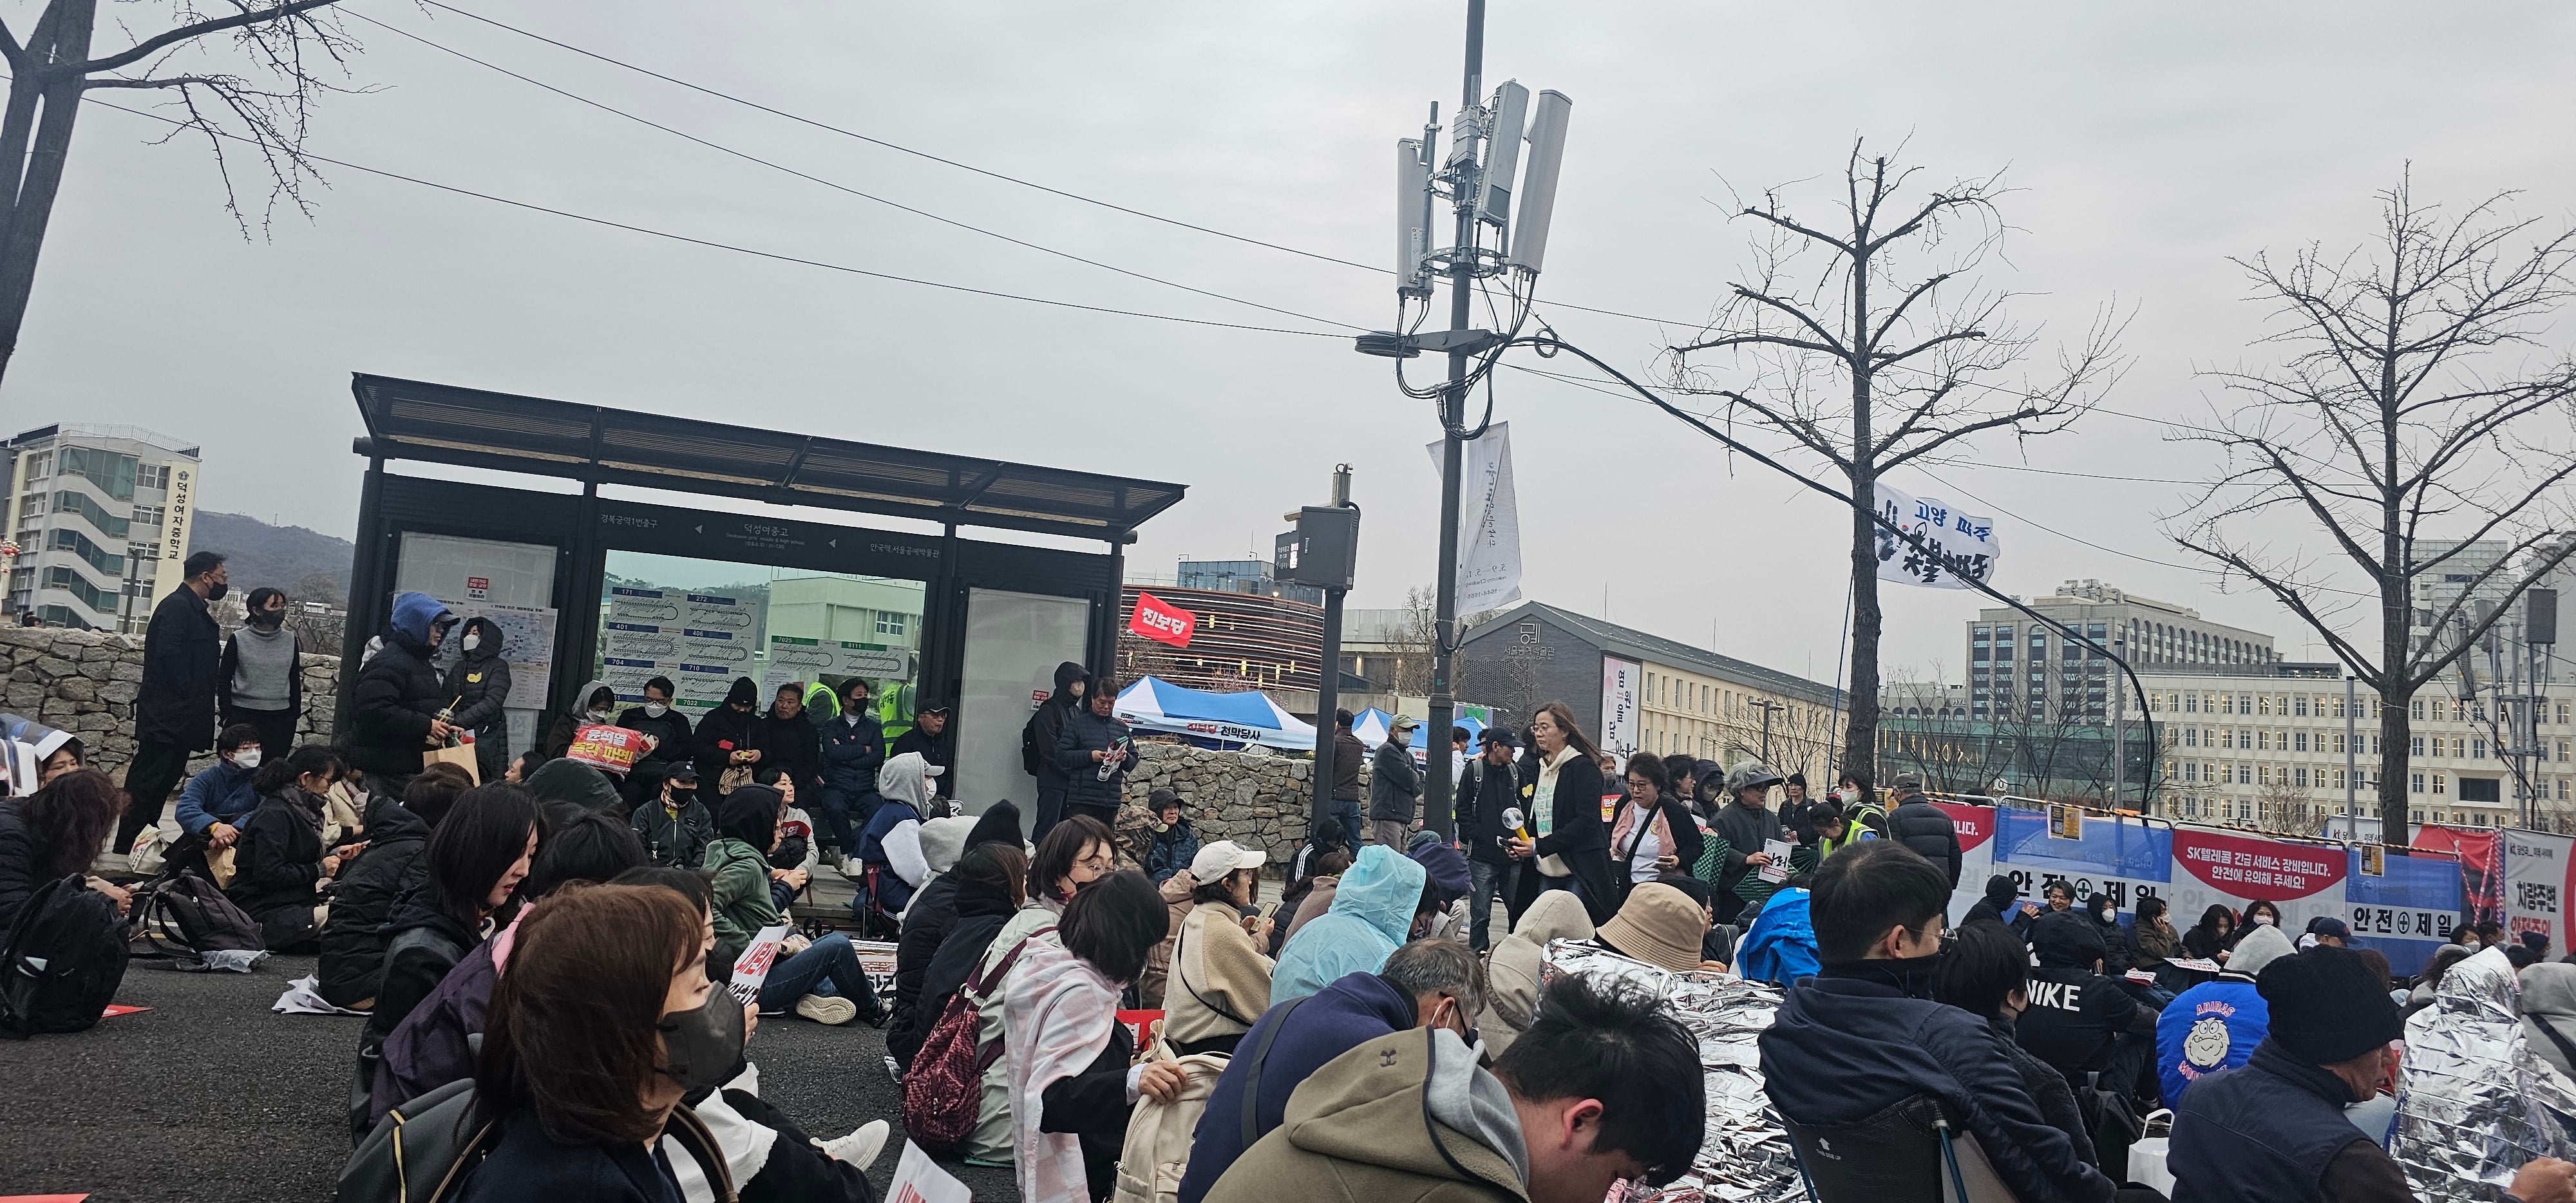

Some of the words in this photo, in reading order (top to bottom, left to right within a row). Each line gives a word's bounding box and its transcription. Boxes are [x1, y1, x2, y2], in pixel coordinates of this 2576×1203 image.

[167, 482, 187, 560] 덕성여자중학교
[601, 514, 658, 529] 경복궁역1번출구
[744, 523, 788, 536] 덕성여중고
[1915, 500, 1947, 527] 고양
[1956, 516, 1990, 542] 파주
[1142, 607, 1187, 635] 진보당
[586, 729, 627, 746] 윤석열
[1186, 722, 1218, 735] 진보당
[1220, 725, 1261, 741] 천막당사
[572, 742, 601, 757] 즉각
[602, 746, 634, 764] 파면!
[2186, 846, 2231, 864] SK텔레콤
[2235, 852, 2251, 866] 긴급
[2253, 855, 2280, 870] 서비스
[2282, 858, 2331, 877] 장비입니다.
[2212, 866, 2242, 882] 안전에
[2244, 871, 2271, 886] 유의해
[2274, 873, 2305, 889] 주세요!
[2516, 880, 2557, 913] 차량주변
[2027, 979, 2081, 1012] NIKE
[2196, 1001, 2236, 1017] ADIDAS
